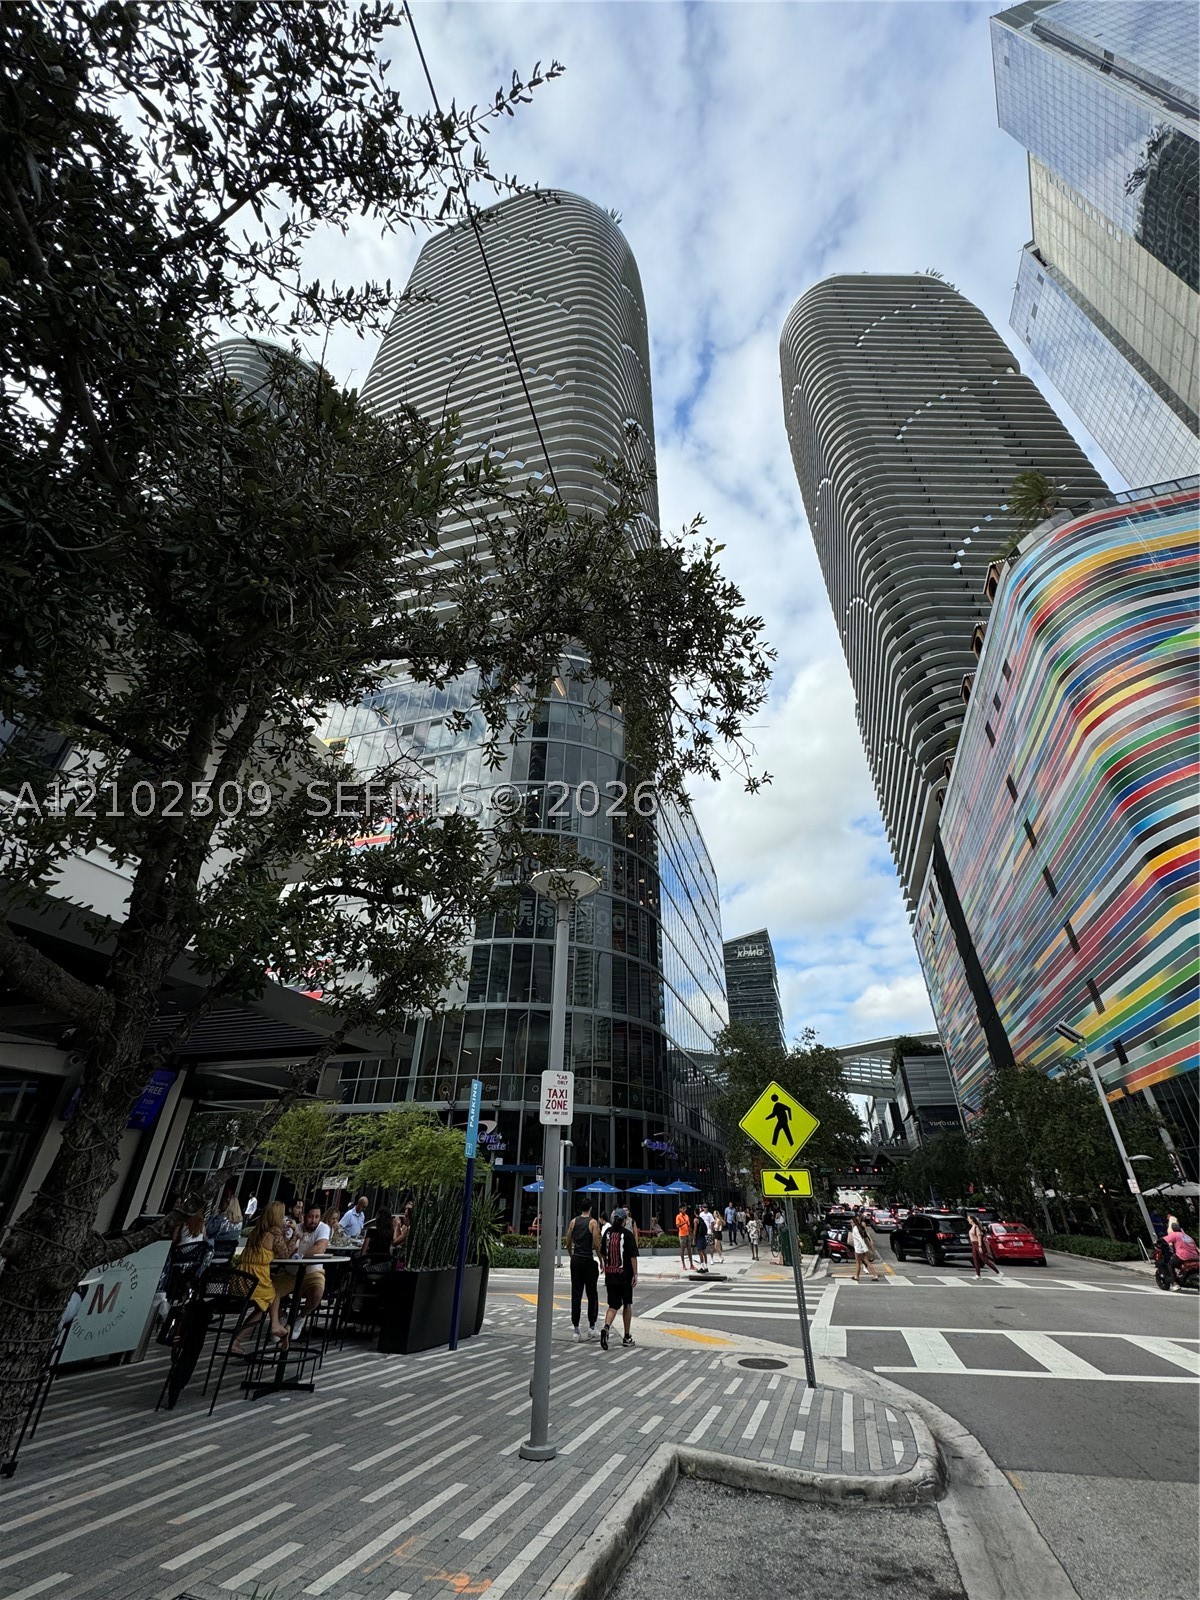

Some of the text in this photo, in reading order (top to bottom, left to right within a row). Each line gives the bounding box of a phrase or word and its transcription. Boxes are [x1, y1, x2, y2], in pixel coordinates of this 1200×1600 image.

[737, 949, 763, 958] KPMG
[548, 1088, 568, 1098] TAXI
[469, 1083, 478, 1128] PARKING
[546, 1100, 568, 1110] ZONE
[87, 1281, 122, 1316] M
